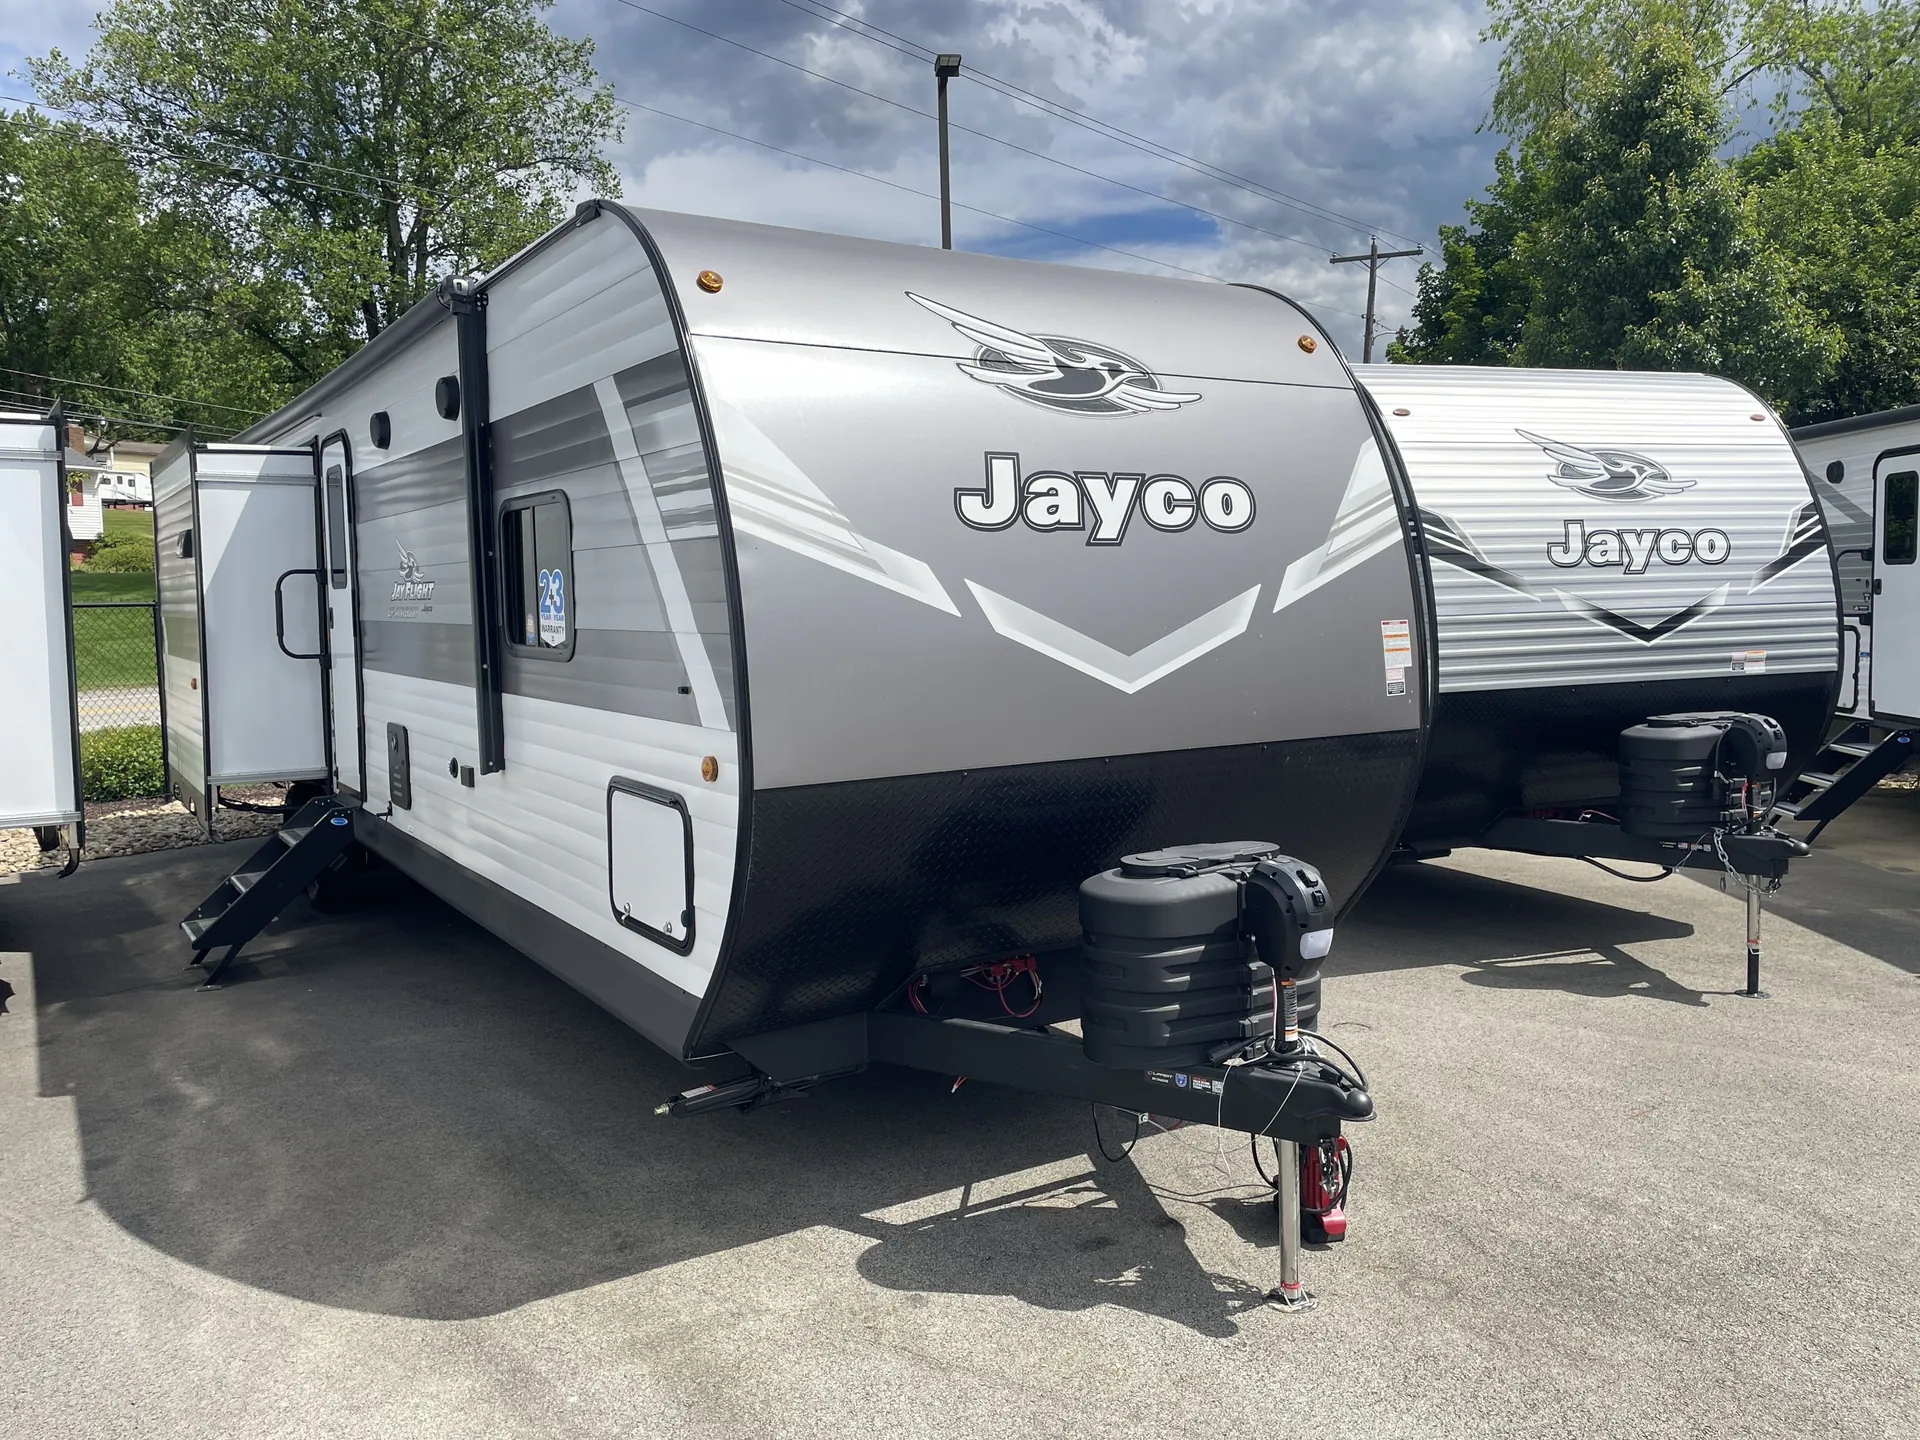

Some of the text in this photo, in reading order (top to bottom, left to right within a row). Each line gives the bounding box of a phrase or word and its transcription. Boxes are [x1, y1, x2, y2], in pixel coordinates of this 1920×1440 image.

[954, 451, 1256, 547] Jayco
[1547, 519, 1732, 575] Jayco
[391, 581, 435, 601] JAY FLIGHT
[553, 614, 564, 622] YEAR
[541, 624, 565, 635] WARRANTY
